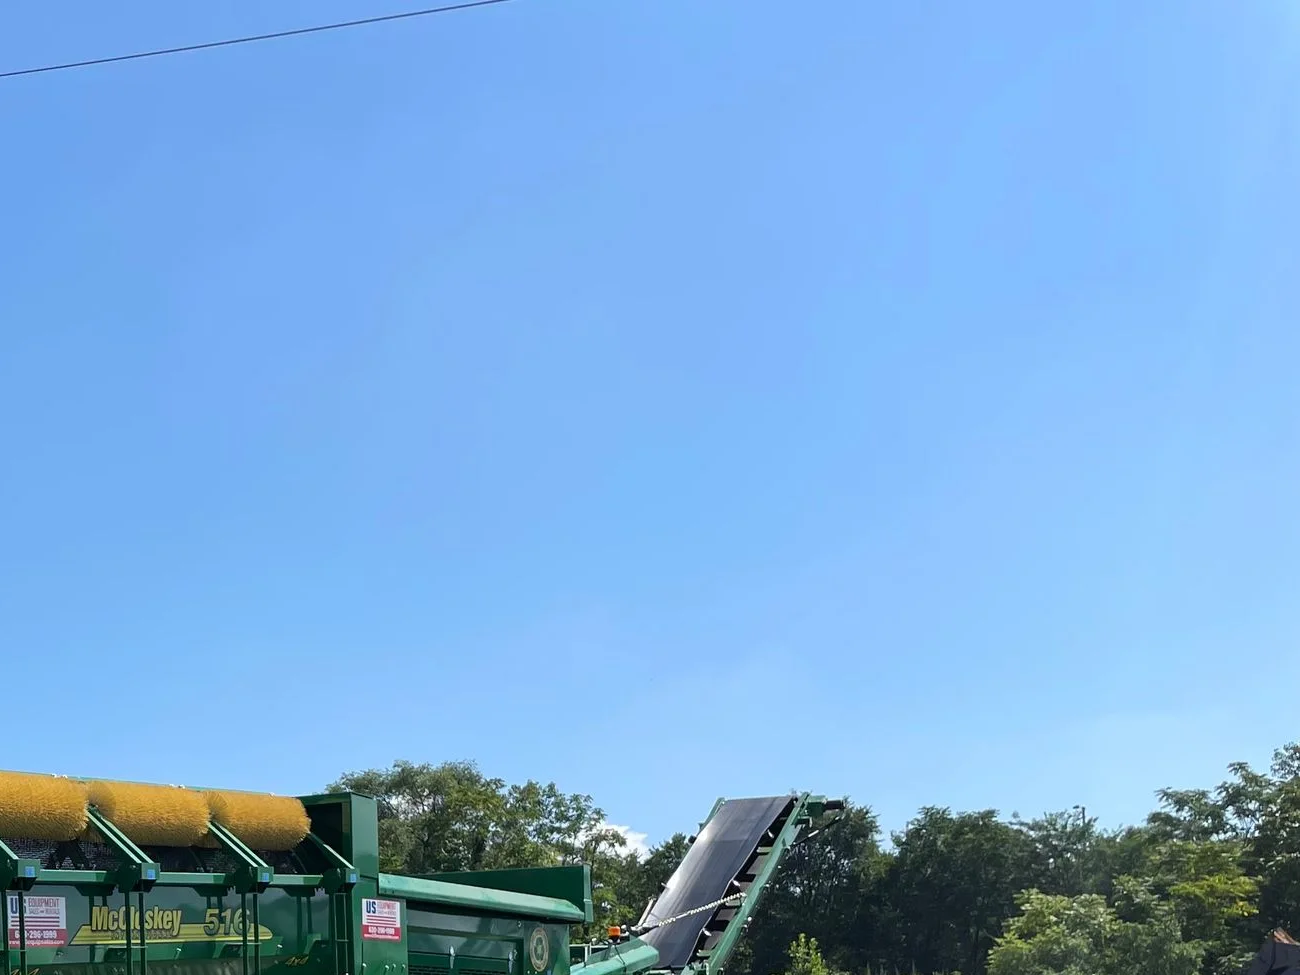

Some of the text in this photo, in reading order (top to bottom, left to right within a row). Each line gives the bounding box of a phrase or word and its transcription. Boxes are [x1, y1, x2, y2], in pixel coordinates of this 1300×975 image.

[28, 898, 60, 908] EQUIPMENT
[366, 900, 377, 914] US
[91, 905, 251, 936] McCloskey 516
